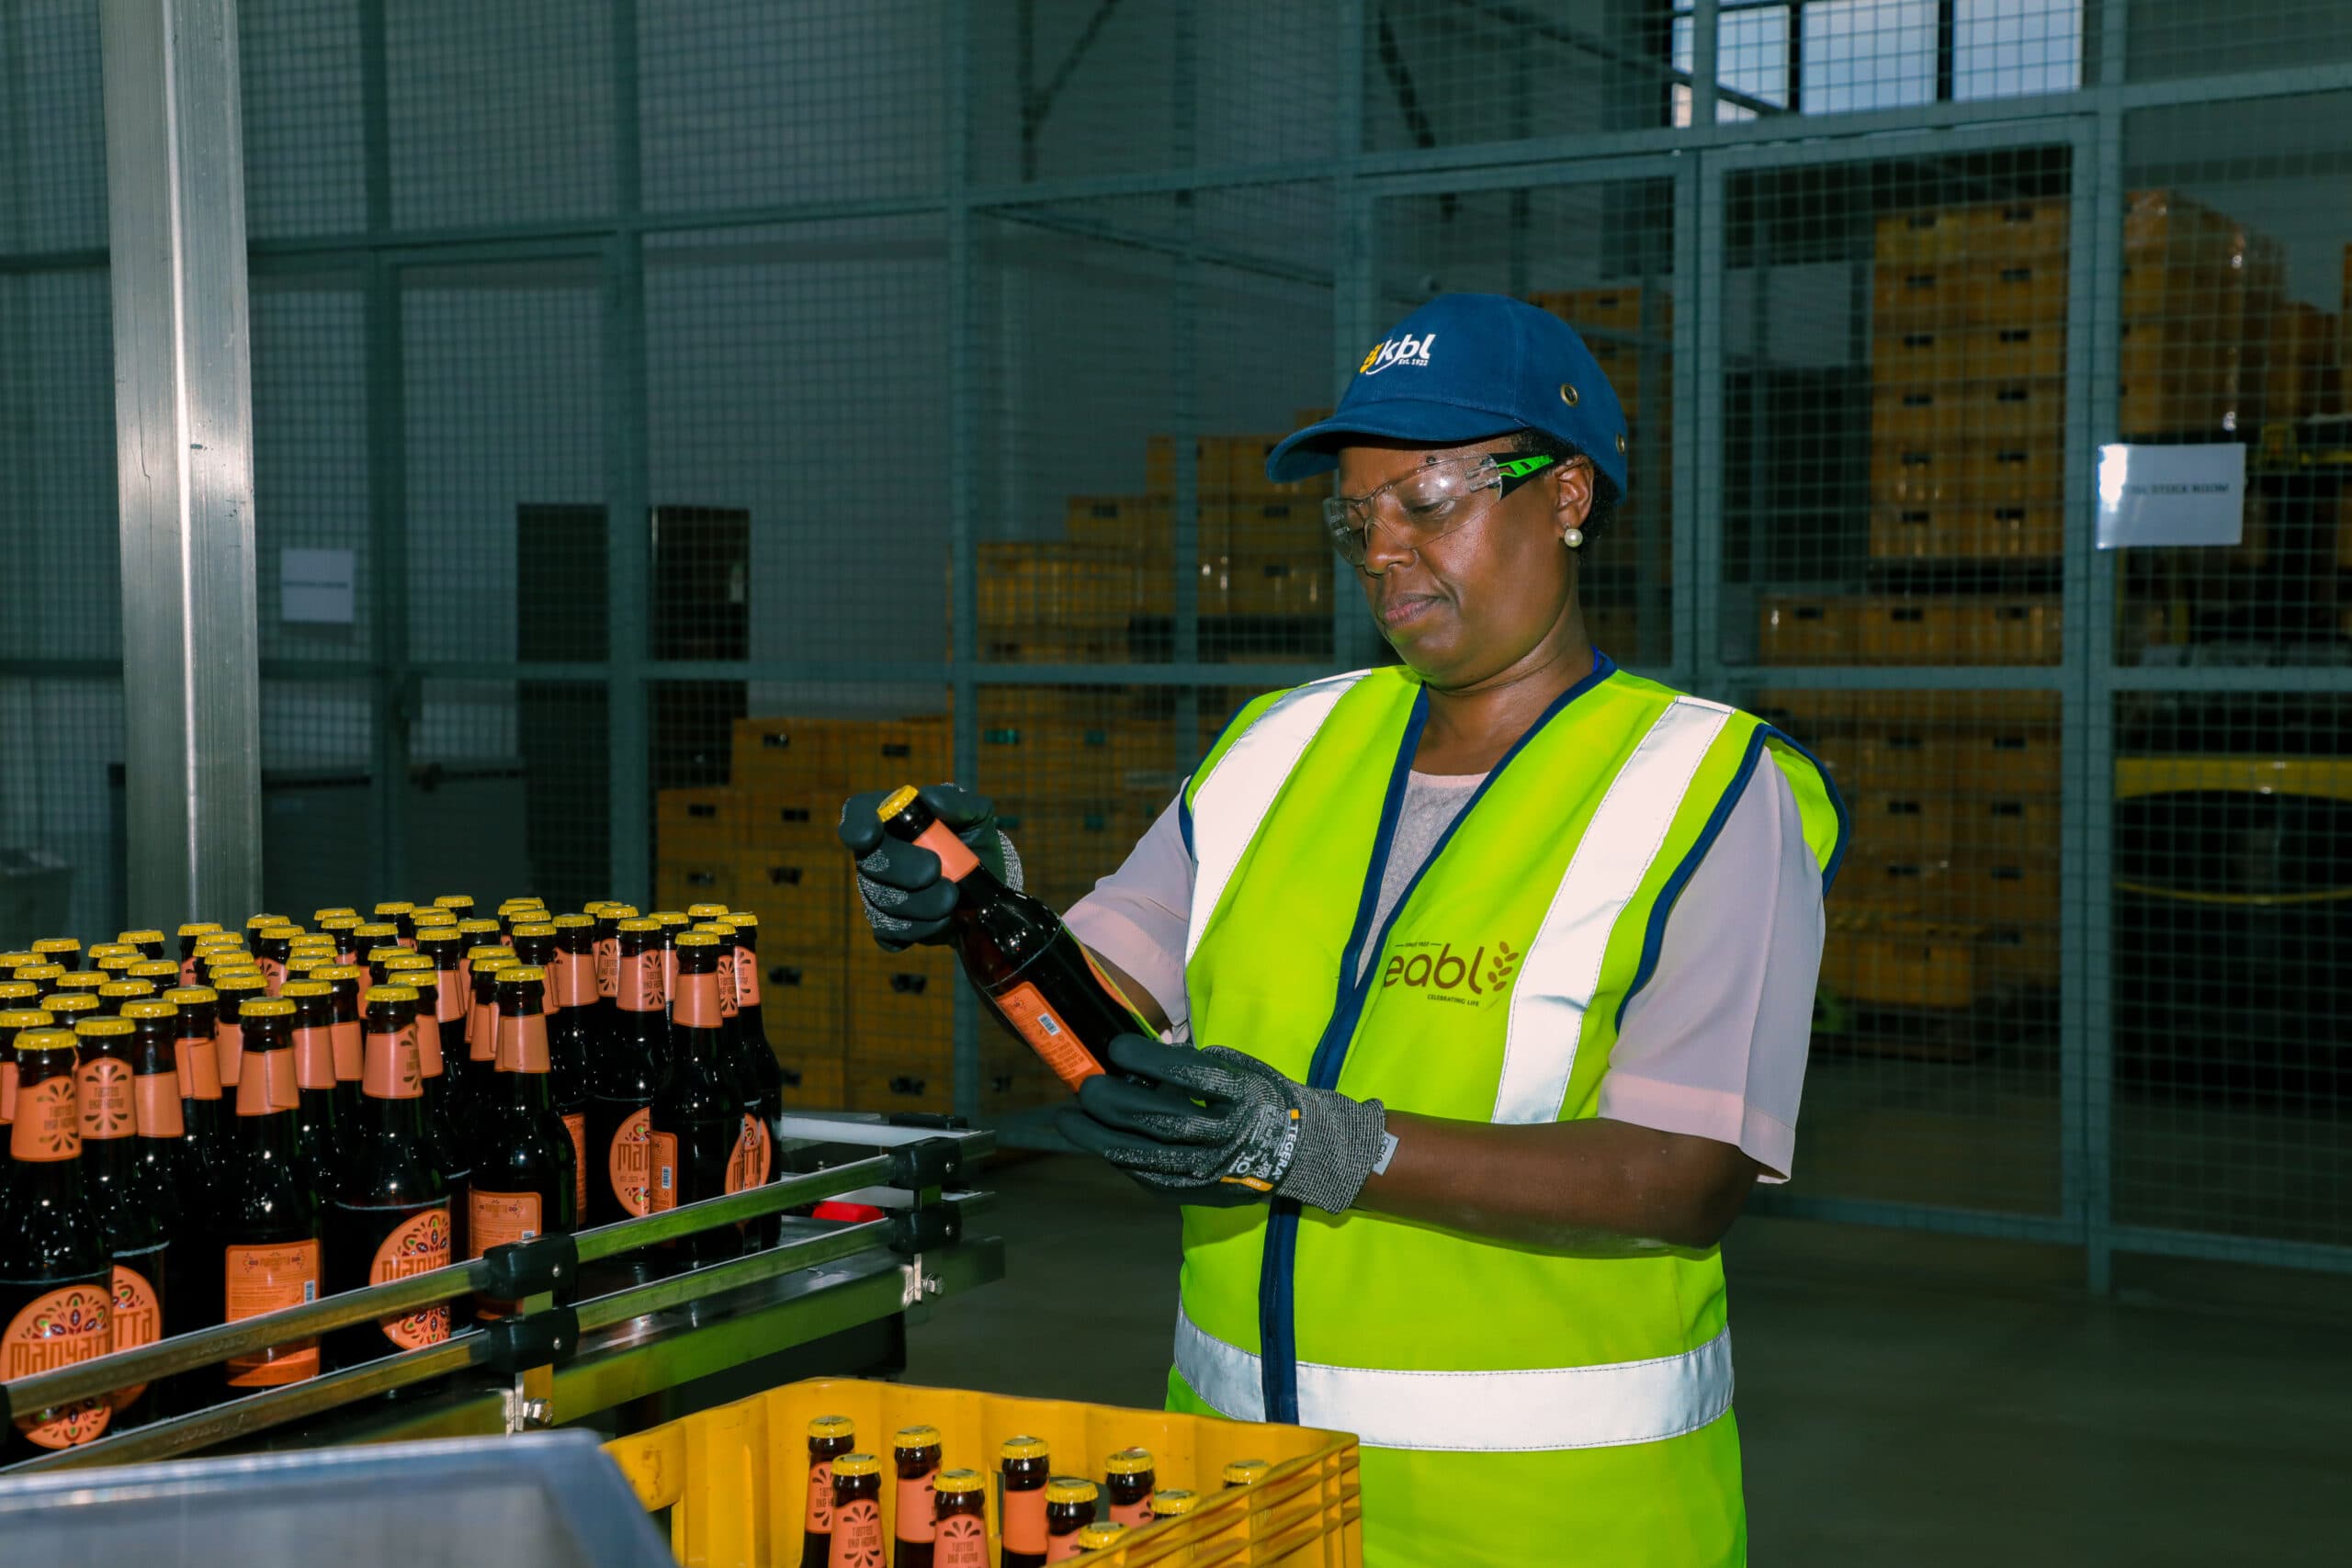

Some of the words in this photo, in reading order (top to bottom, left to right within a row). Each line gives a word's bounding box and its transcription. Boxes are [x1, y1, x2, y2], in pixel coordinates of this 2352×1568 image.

[1366, 333, 1436, 375] kbl
[1384, 943, 1485, 995] eabl
[1427, 993, 1465, 1005] CELEBRATING
[1272, 1123, 1298, 1176] TEGERA
